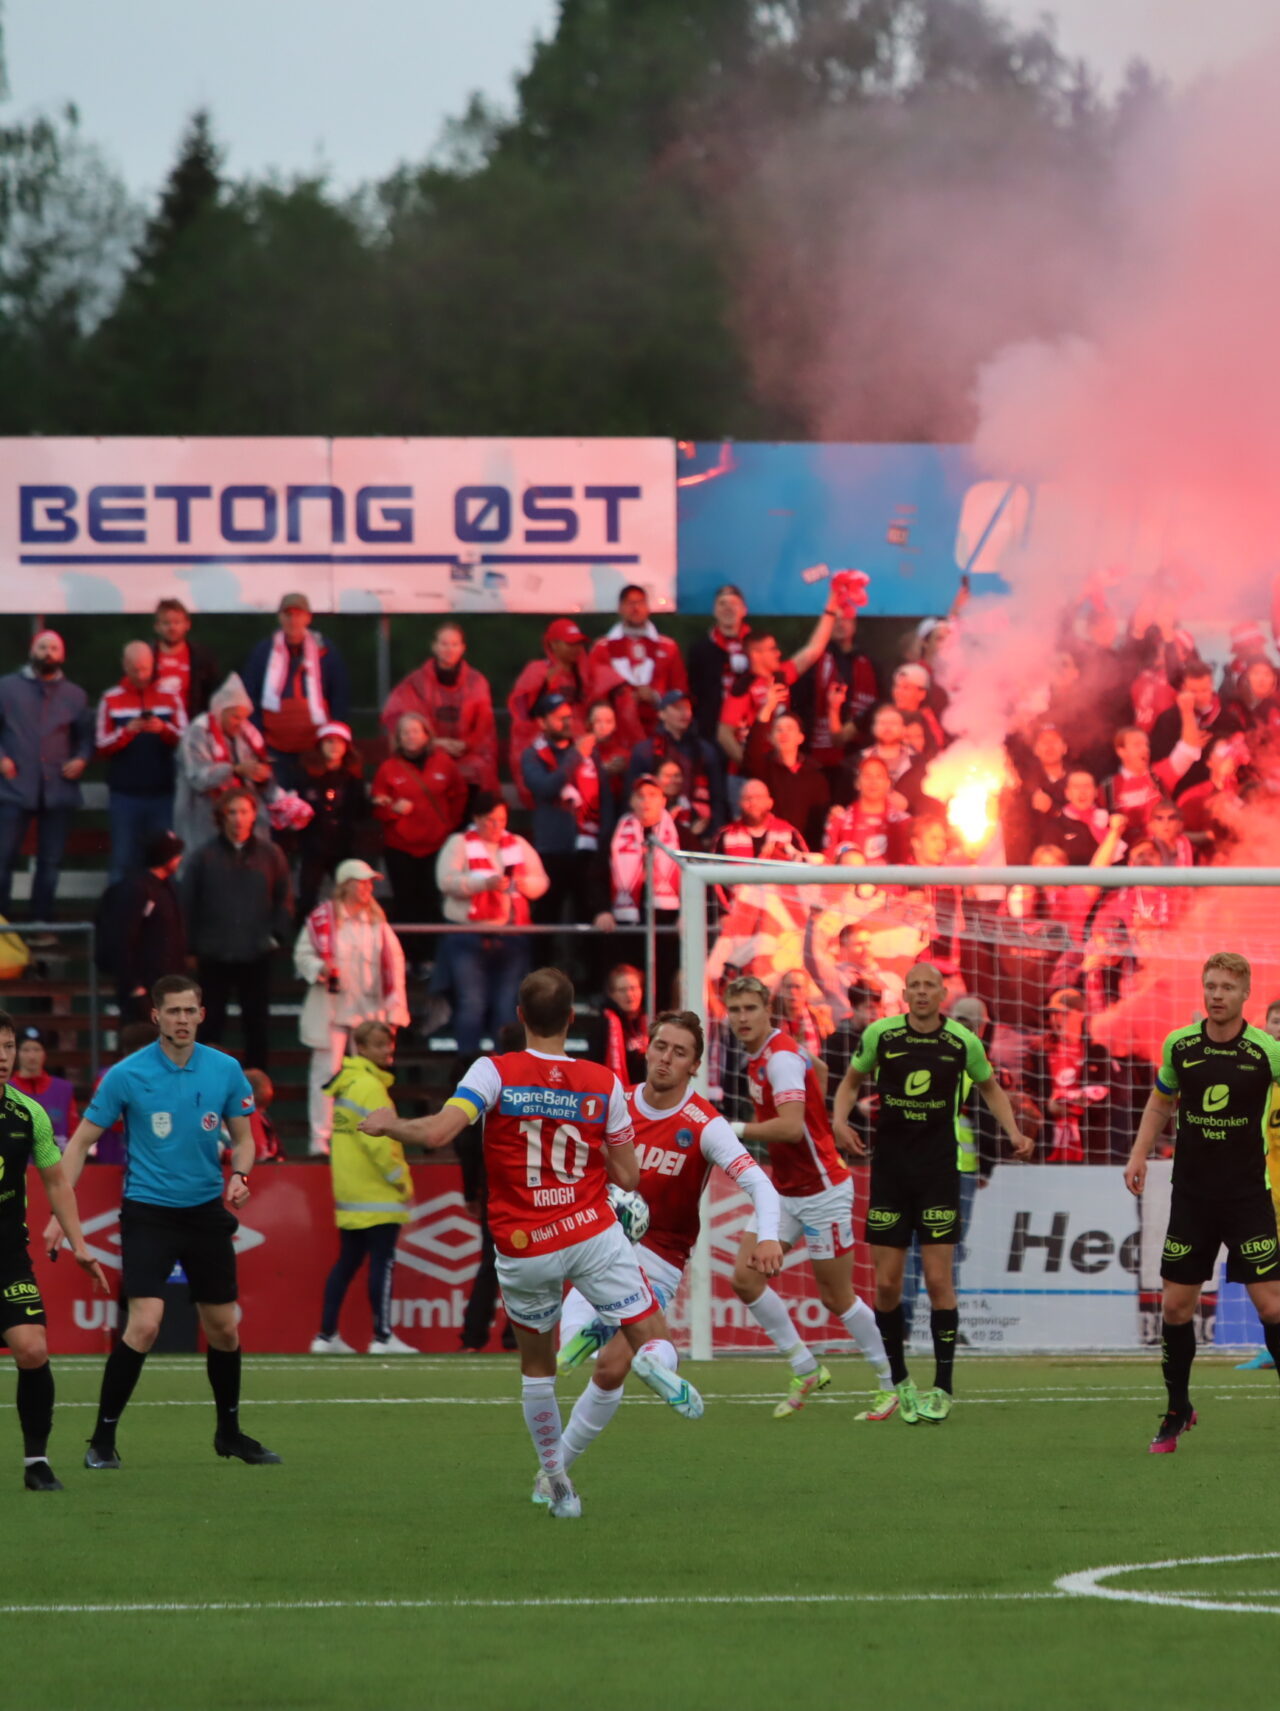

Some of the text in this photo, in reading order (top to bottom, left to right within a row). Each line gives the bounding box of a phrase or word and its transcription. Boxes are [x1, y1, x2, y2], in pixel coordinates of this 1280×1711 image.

[20, 485, 642, 543] BETONG ØST
[502, 1088, 597, 1117] SpareBank 1
[885, 1094, 946, 1109] Sparebanken
[522, 1104, 577, 1118] ØSTLANDET
[903, 1109, 928, 1121] Vest
[1186, 1110, 1248, 1127] Sparebanken
[1202, 1128, 1227, 1140] Vest
[519, 1119, 590, 1187] 10
[634, 1143, 687, 1177] APEI
[533, 1187, 576, 1208] KROGH
[923, 1209, 956, 1221] LERØY
[531, 1208, 599, 1244] RIGHT TO PLAY
[1241, 1237, 1276, 1255] LERØY
